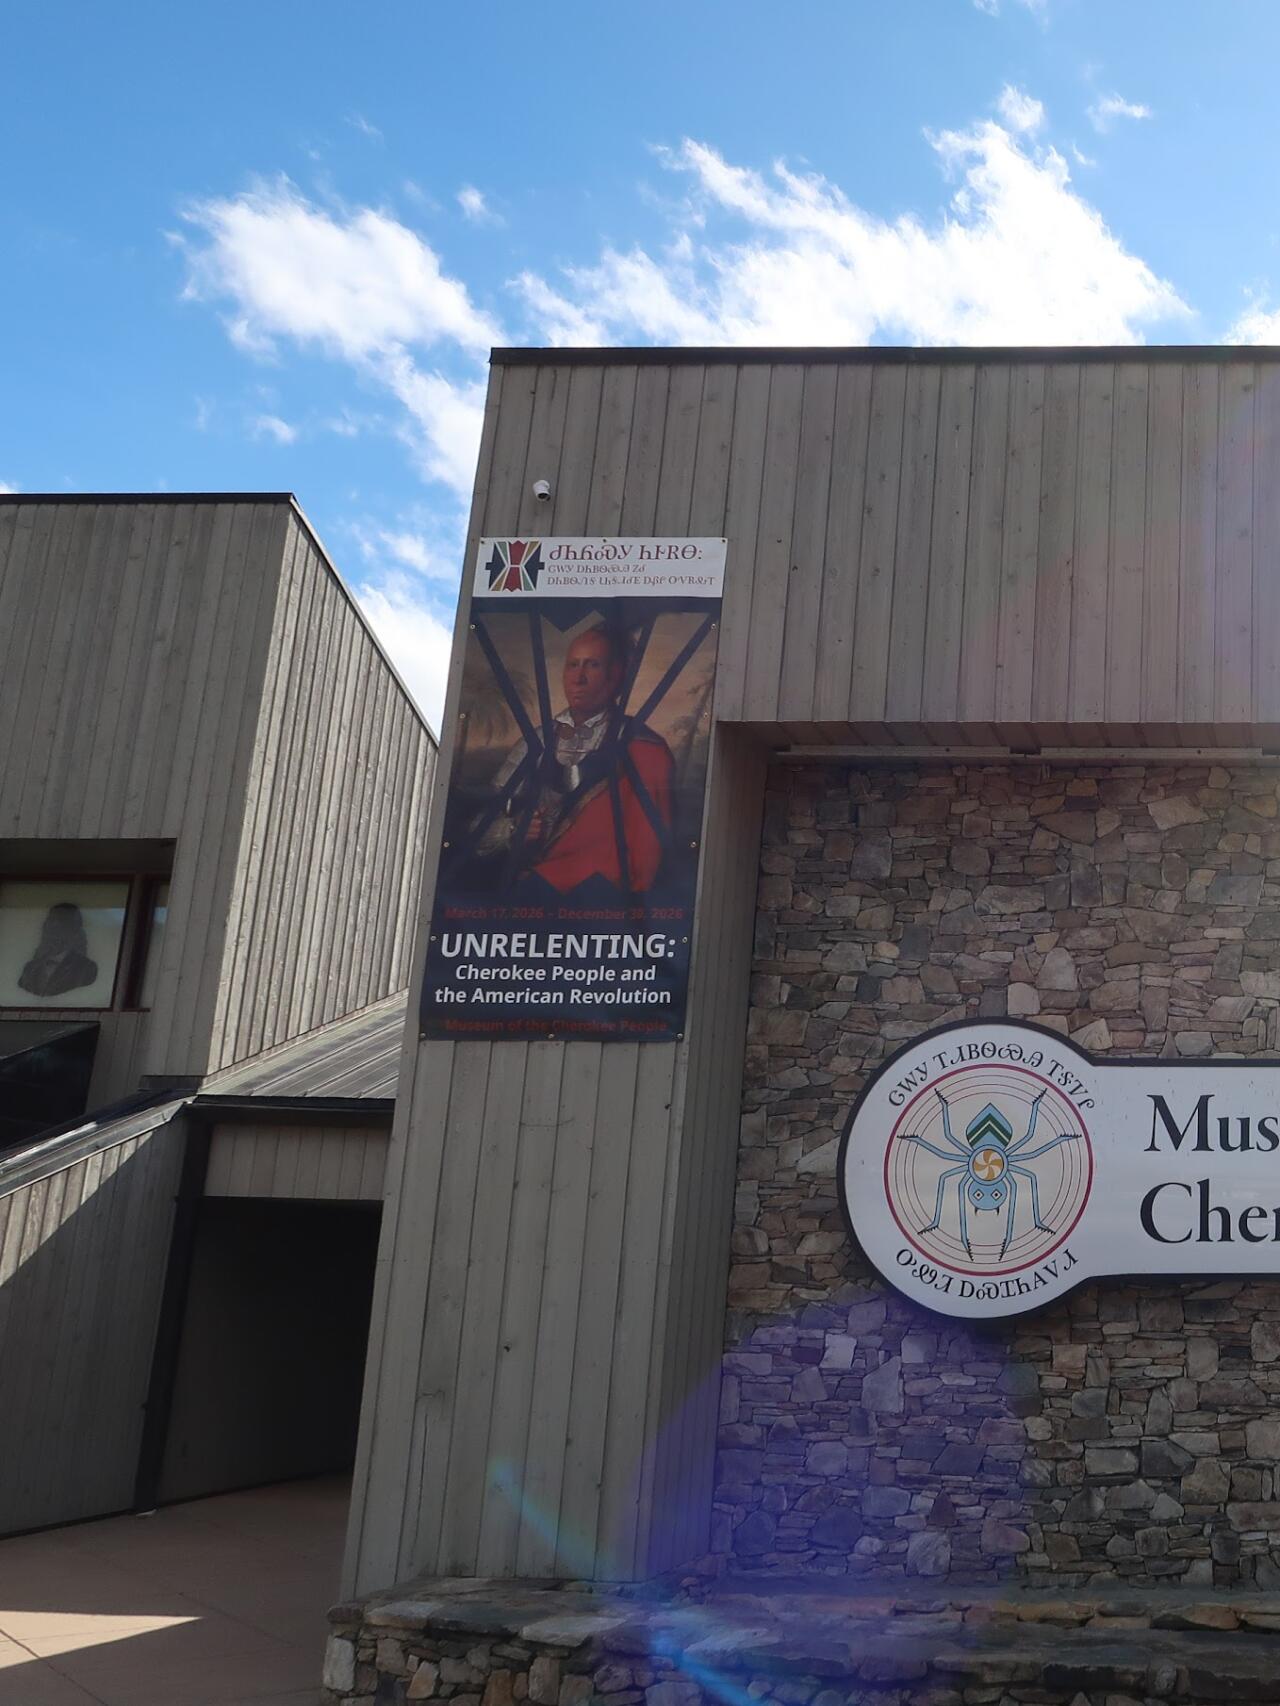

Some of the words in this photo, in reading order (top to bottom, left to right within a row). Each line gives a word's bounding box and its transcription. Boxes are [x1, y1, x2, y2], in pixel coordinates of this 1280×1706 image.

[445, 907, 488, 919] March
[511, 907, 544, 919] 2026
[559, 908, 625, 920] December
[651, 908, 684, 920] 2026
[441, 933, 677, 959] UNRELENTING:
[455, 964, 547, 981] Cherokee
[551, 965, 616, 985] People
[620, 965, 657, 981] and
[435, 987, 467, 1004] the
[471, 988, 565, 1004] American
[570, 988, 672, 1004] Revolution
[446, 1019, 503, 1031] Museum
[509, 1018, 524, 1031] of
[526, 1019, 548, 1031] the
[552, 1019, 616, 1032] Cherokee
[622, 1019, 669, 1034] People
